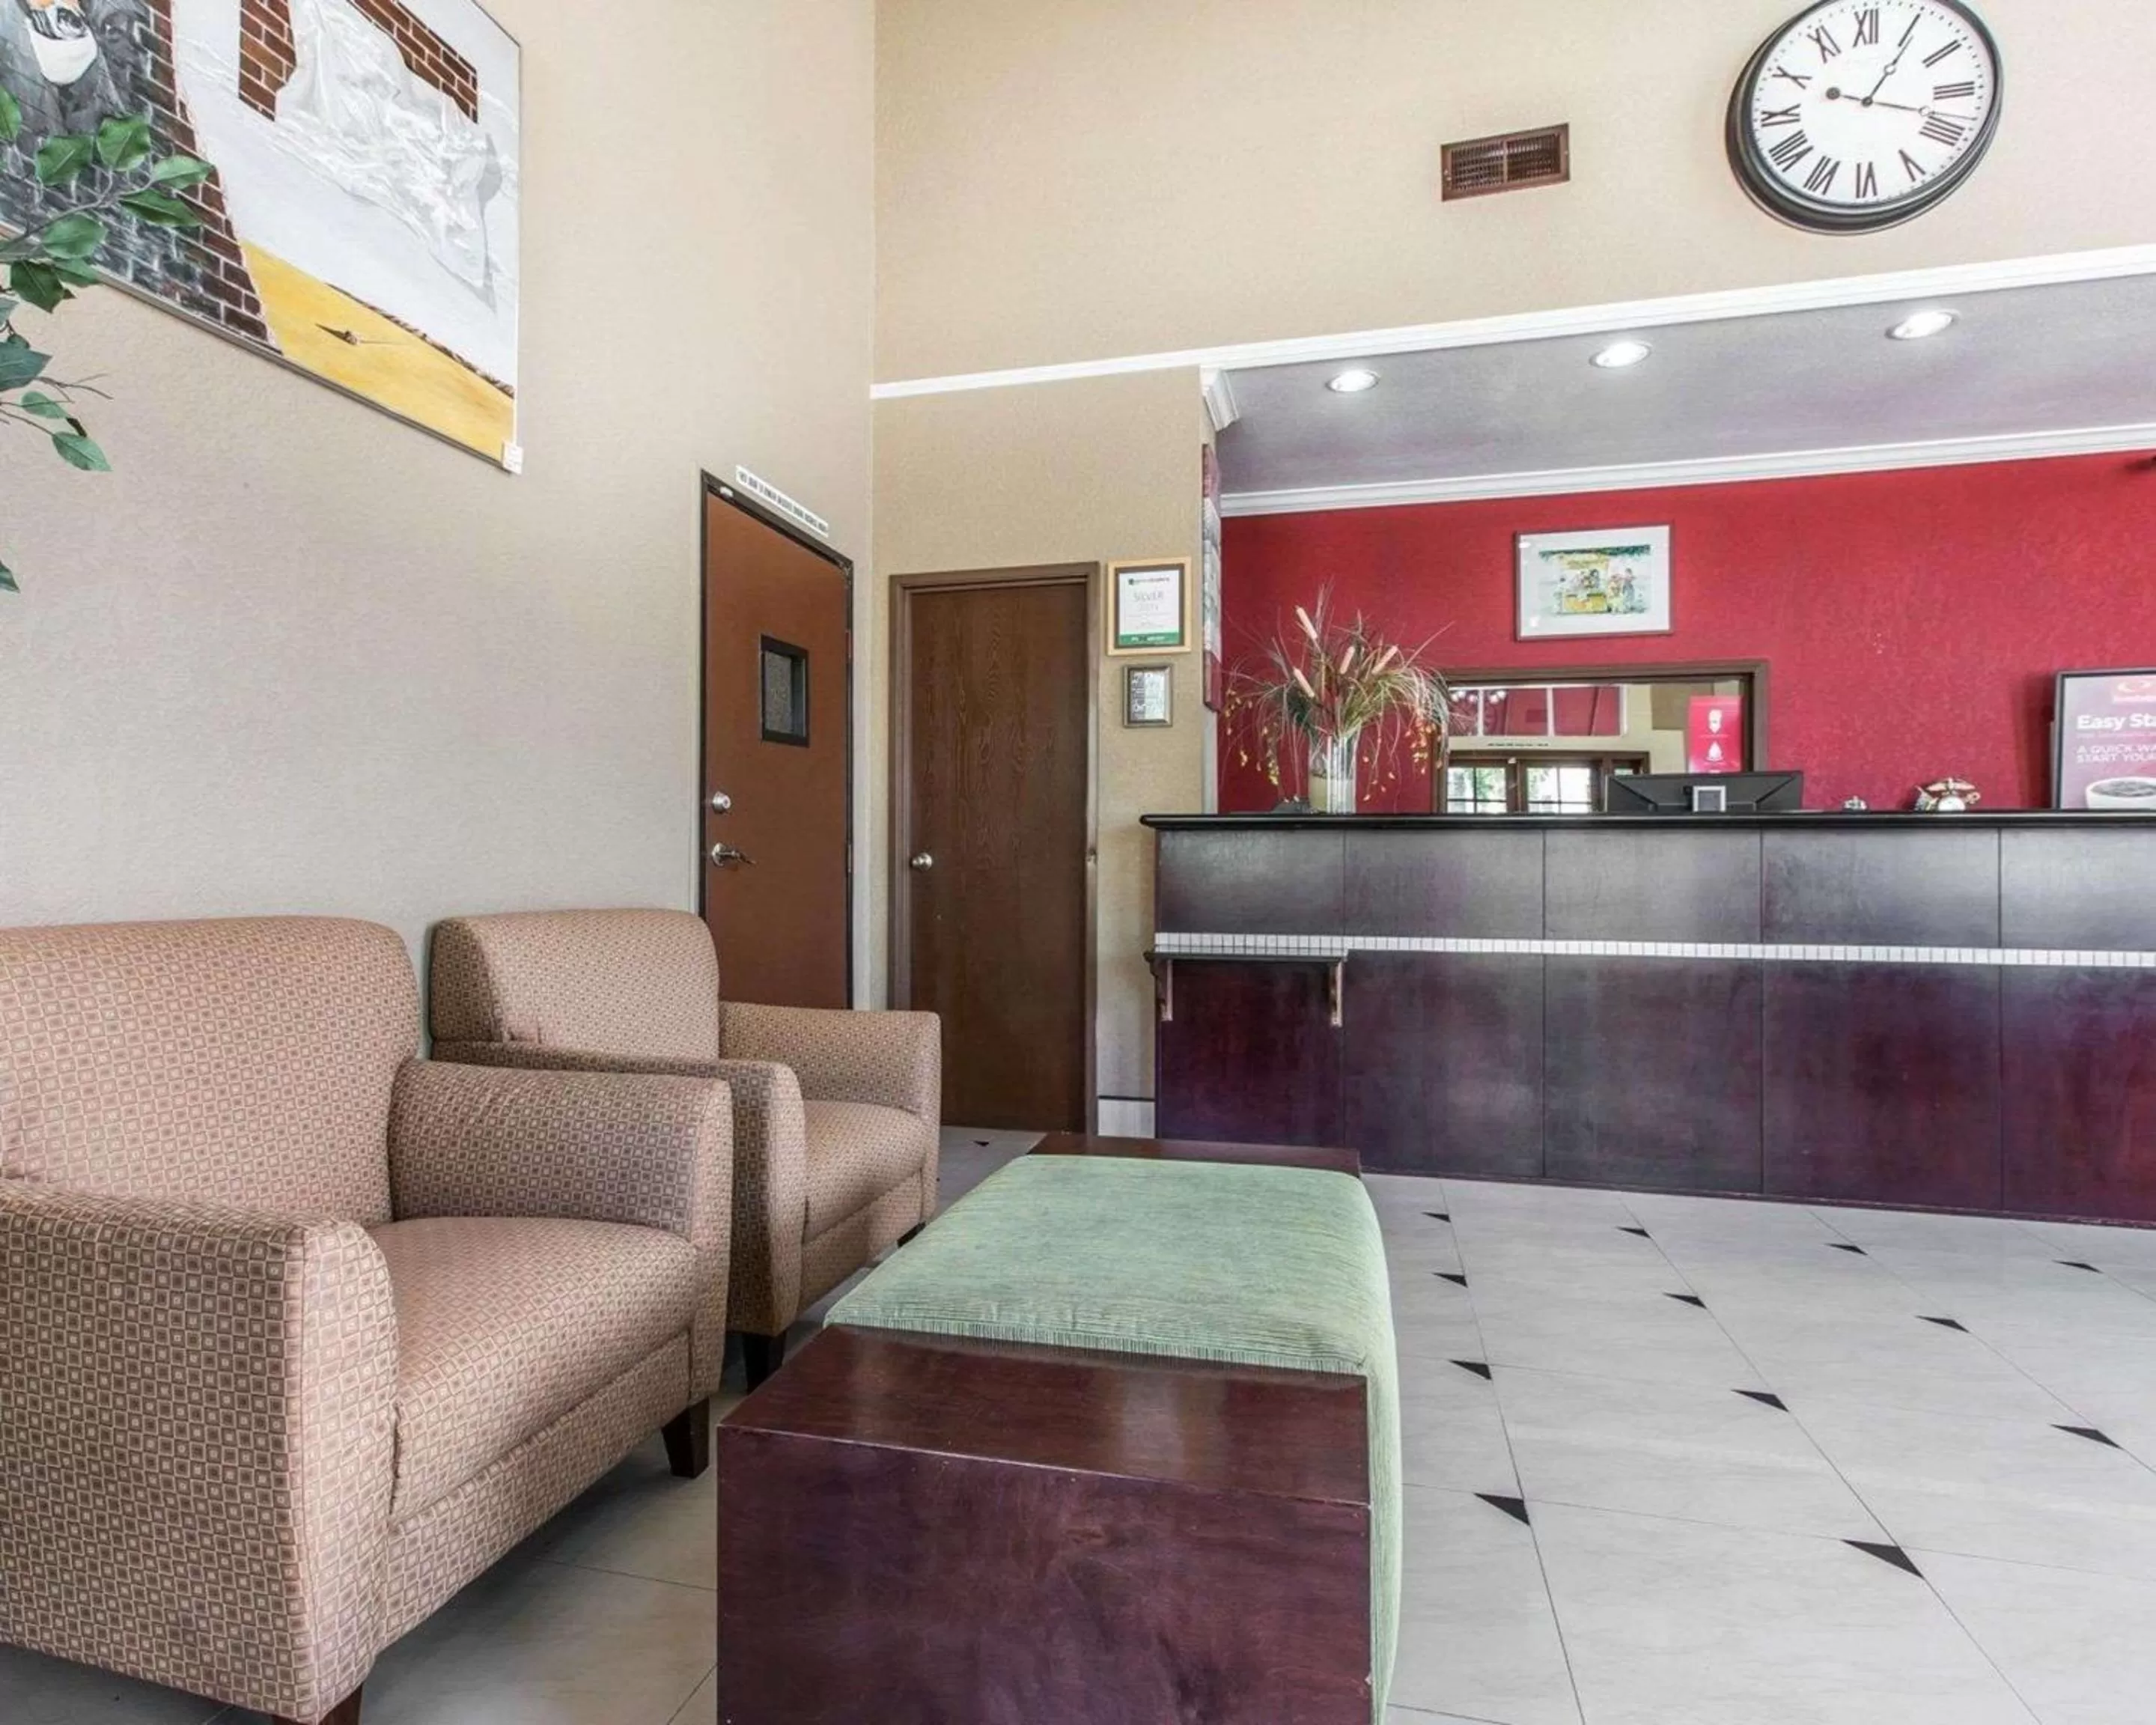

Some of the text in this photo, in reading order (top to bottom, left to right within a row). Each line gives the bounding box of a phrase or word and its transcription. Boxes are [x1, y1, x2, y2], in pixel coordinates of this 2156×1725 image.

[1806, 25, 1842, 64] XI
[1853, 8, 1879, 49] XII
[1922, 39, 1962, 68] II
[1771, 65, 1812, 90] X
[1933, 80, 1976, 100] III
[1760, 103, 1801, 127] IX
[1768, 130, 1815, 172] VIII
[1898, 149, 1926, 182] V
[1803, 155, 1841, 195] VII
[1857, 161, 1878, 199] VI
[2077, 714, 2126, 731] Easy
